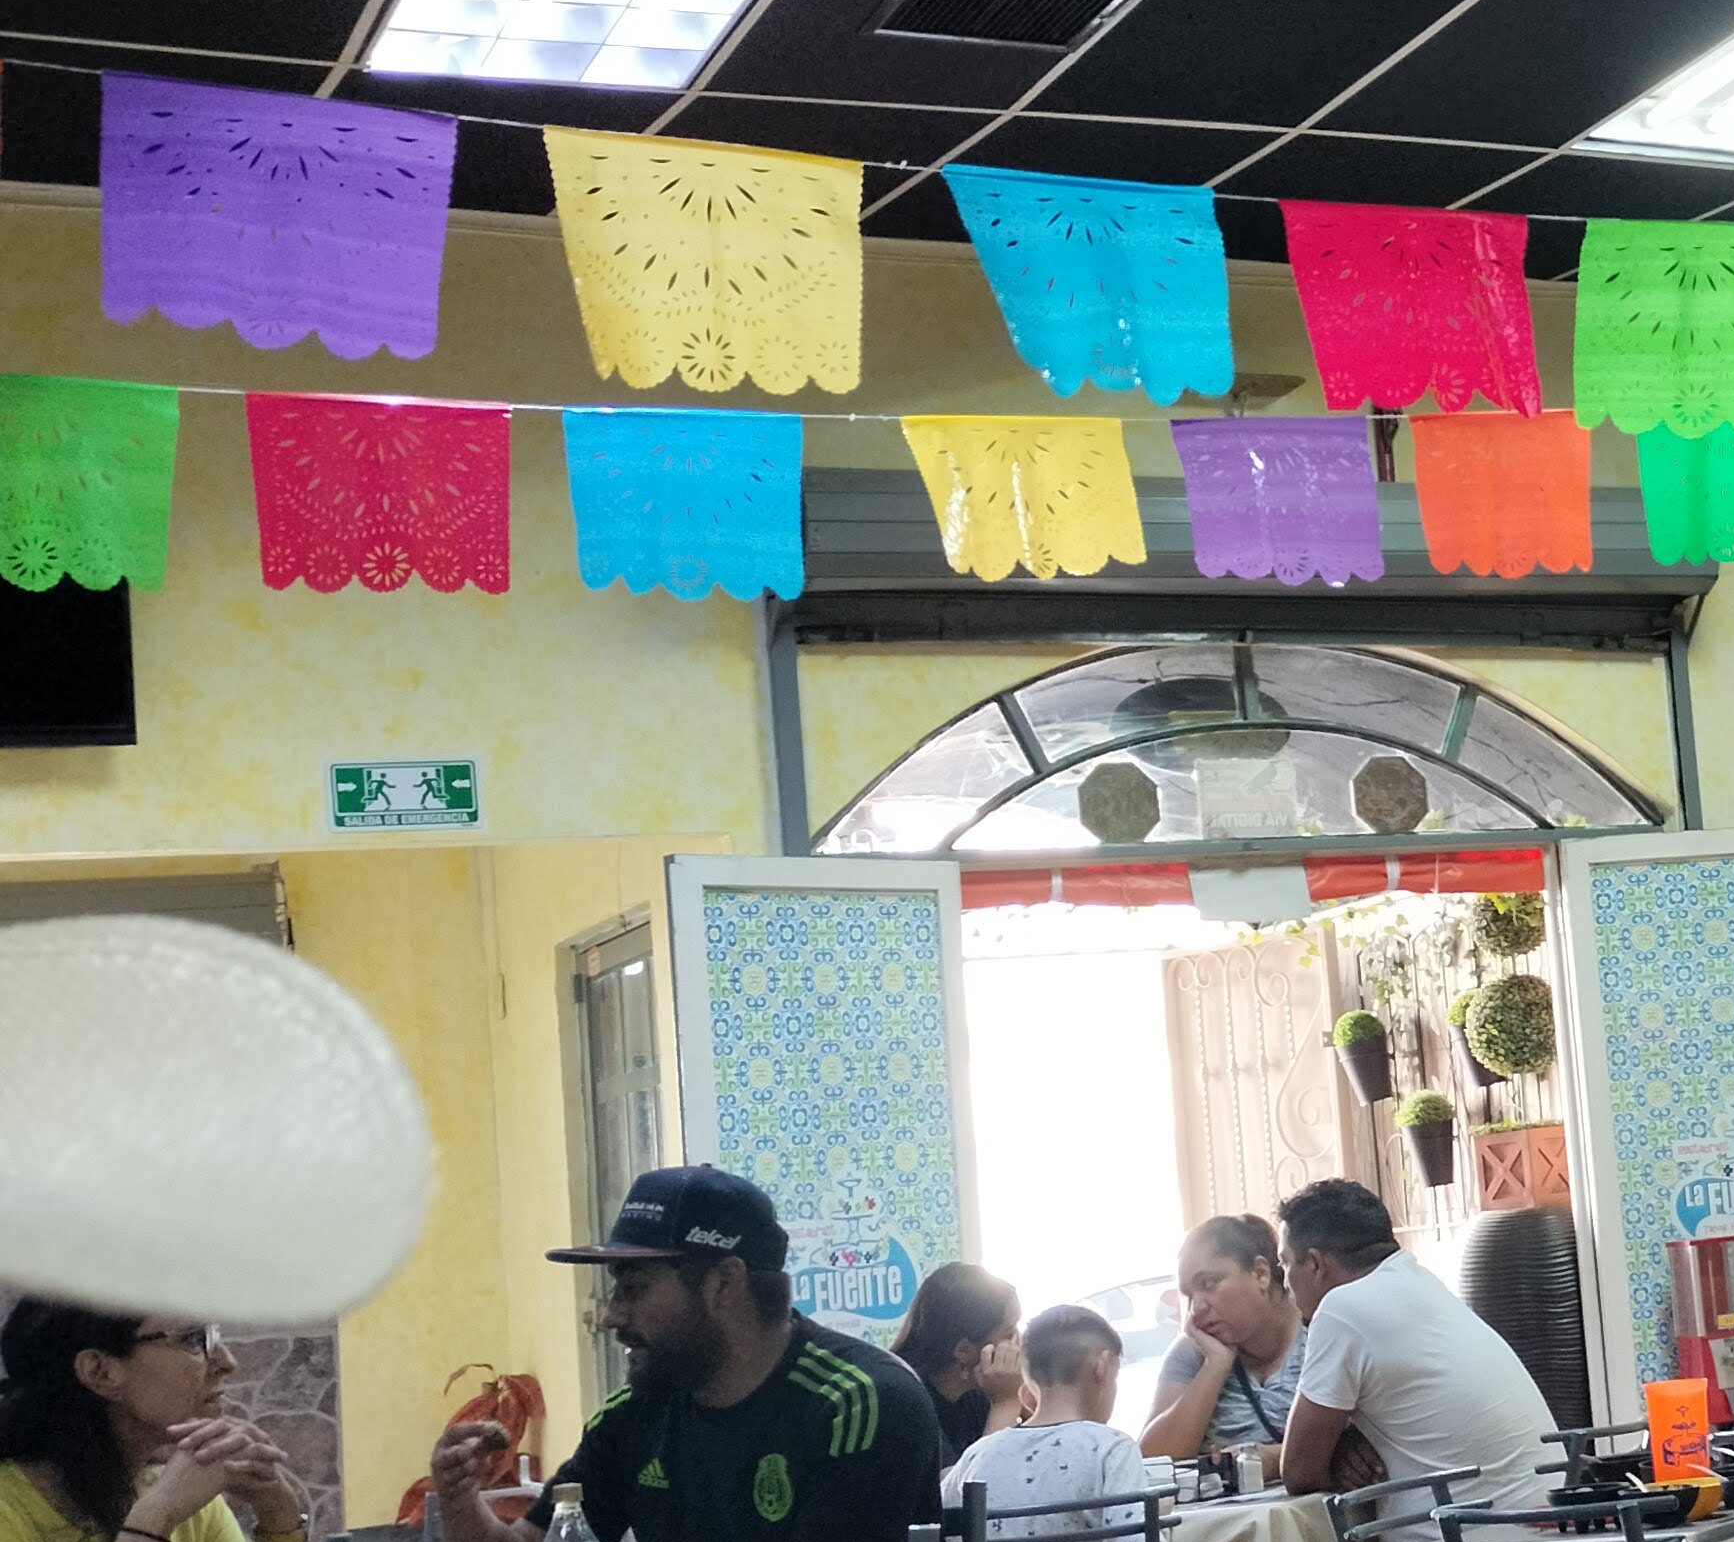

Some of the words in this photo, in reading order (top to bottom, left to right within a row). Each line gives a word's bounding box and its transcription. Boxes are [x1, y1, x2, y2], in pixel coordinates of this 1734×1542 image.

[343, 815, 383, 827] SALIDA
[384, 814, 399, 825] DE
[400, 812, 469, 825] EMERGENCIA
[685, 1225, 742, 1250] telcel
